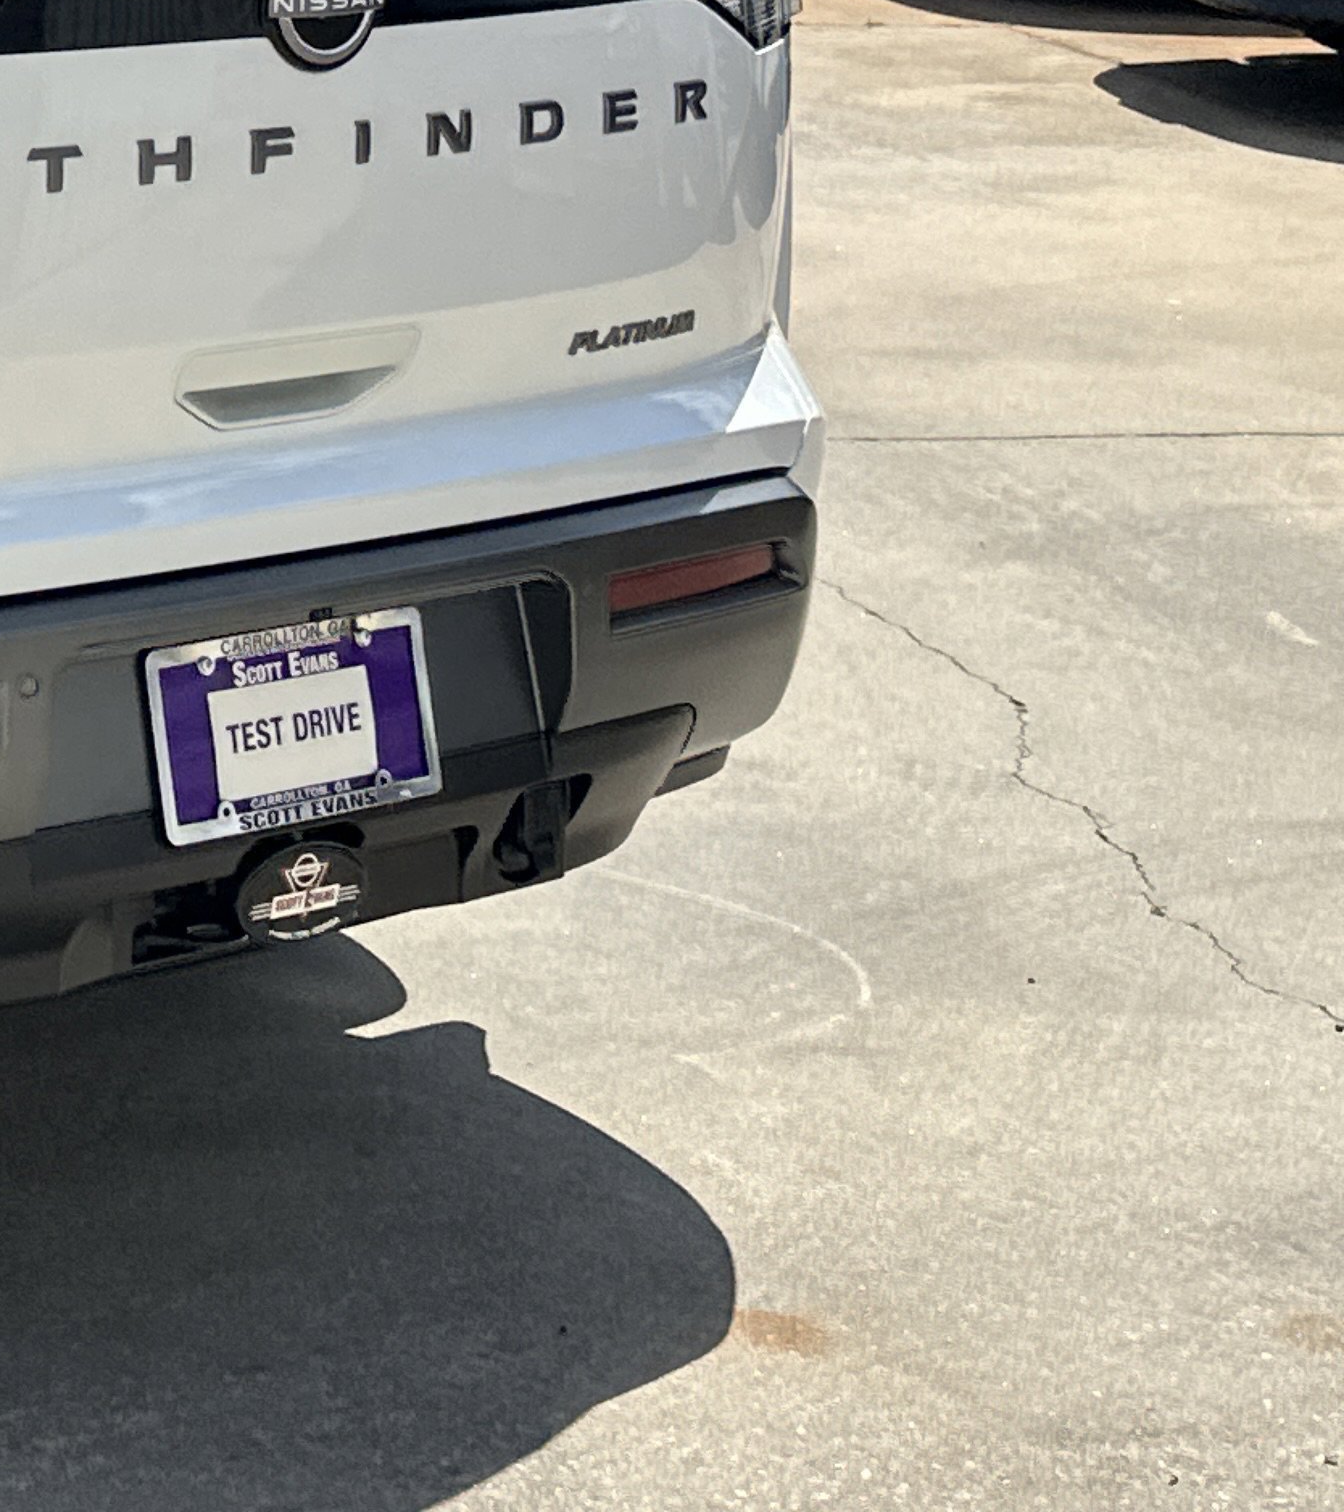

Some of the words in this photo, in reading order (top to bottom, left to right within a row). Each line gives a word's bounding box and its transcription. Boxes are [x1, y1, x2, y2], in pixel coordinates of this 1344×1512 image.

[568, 309, 695, 355] PLATINUM
[225, 715, 283, 754] TEST
[292, 702, 362, 742] DRIVE
[239, 804, 303, 831] SCOTT
[311, 791, 378, 817] EVANS
